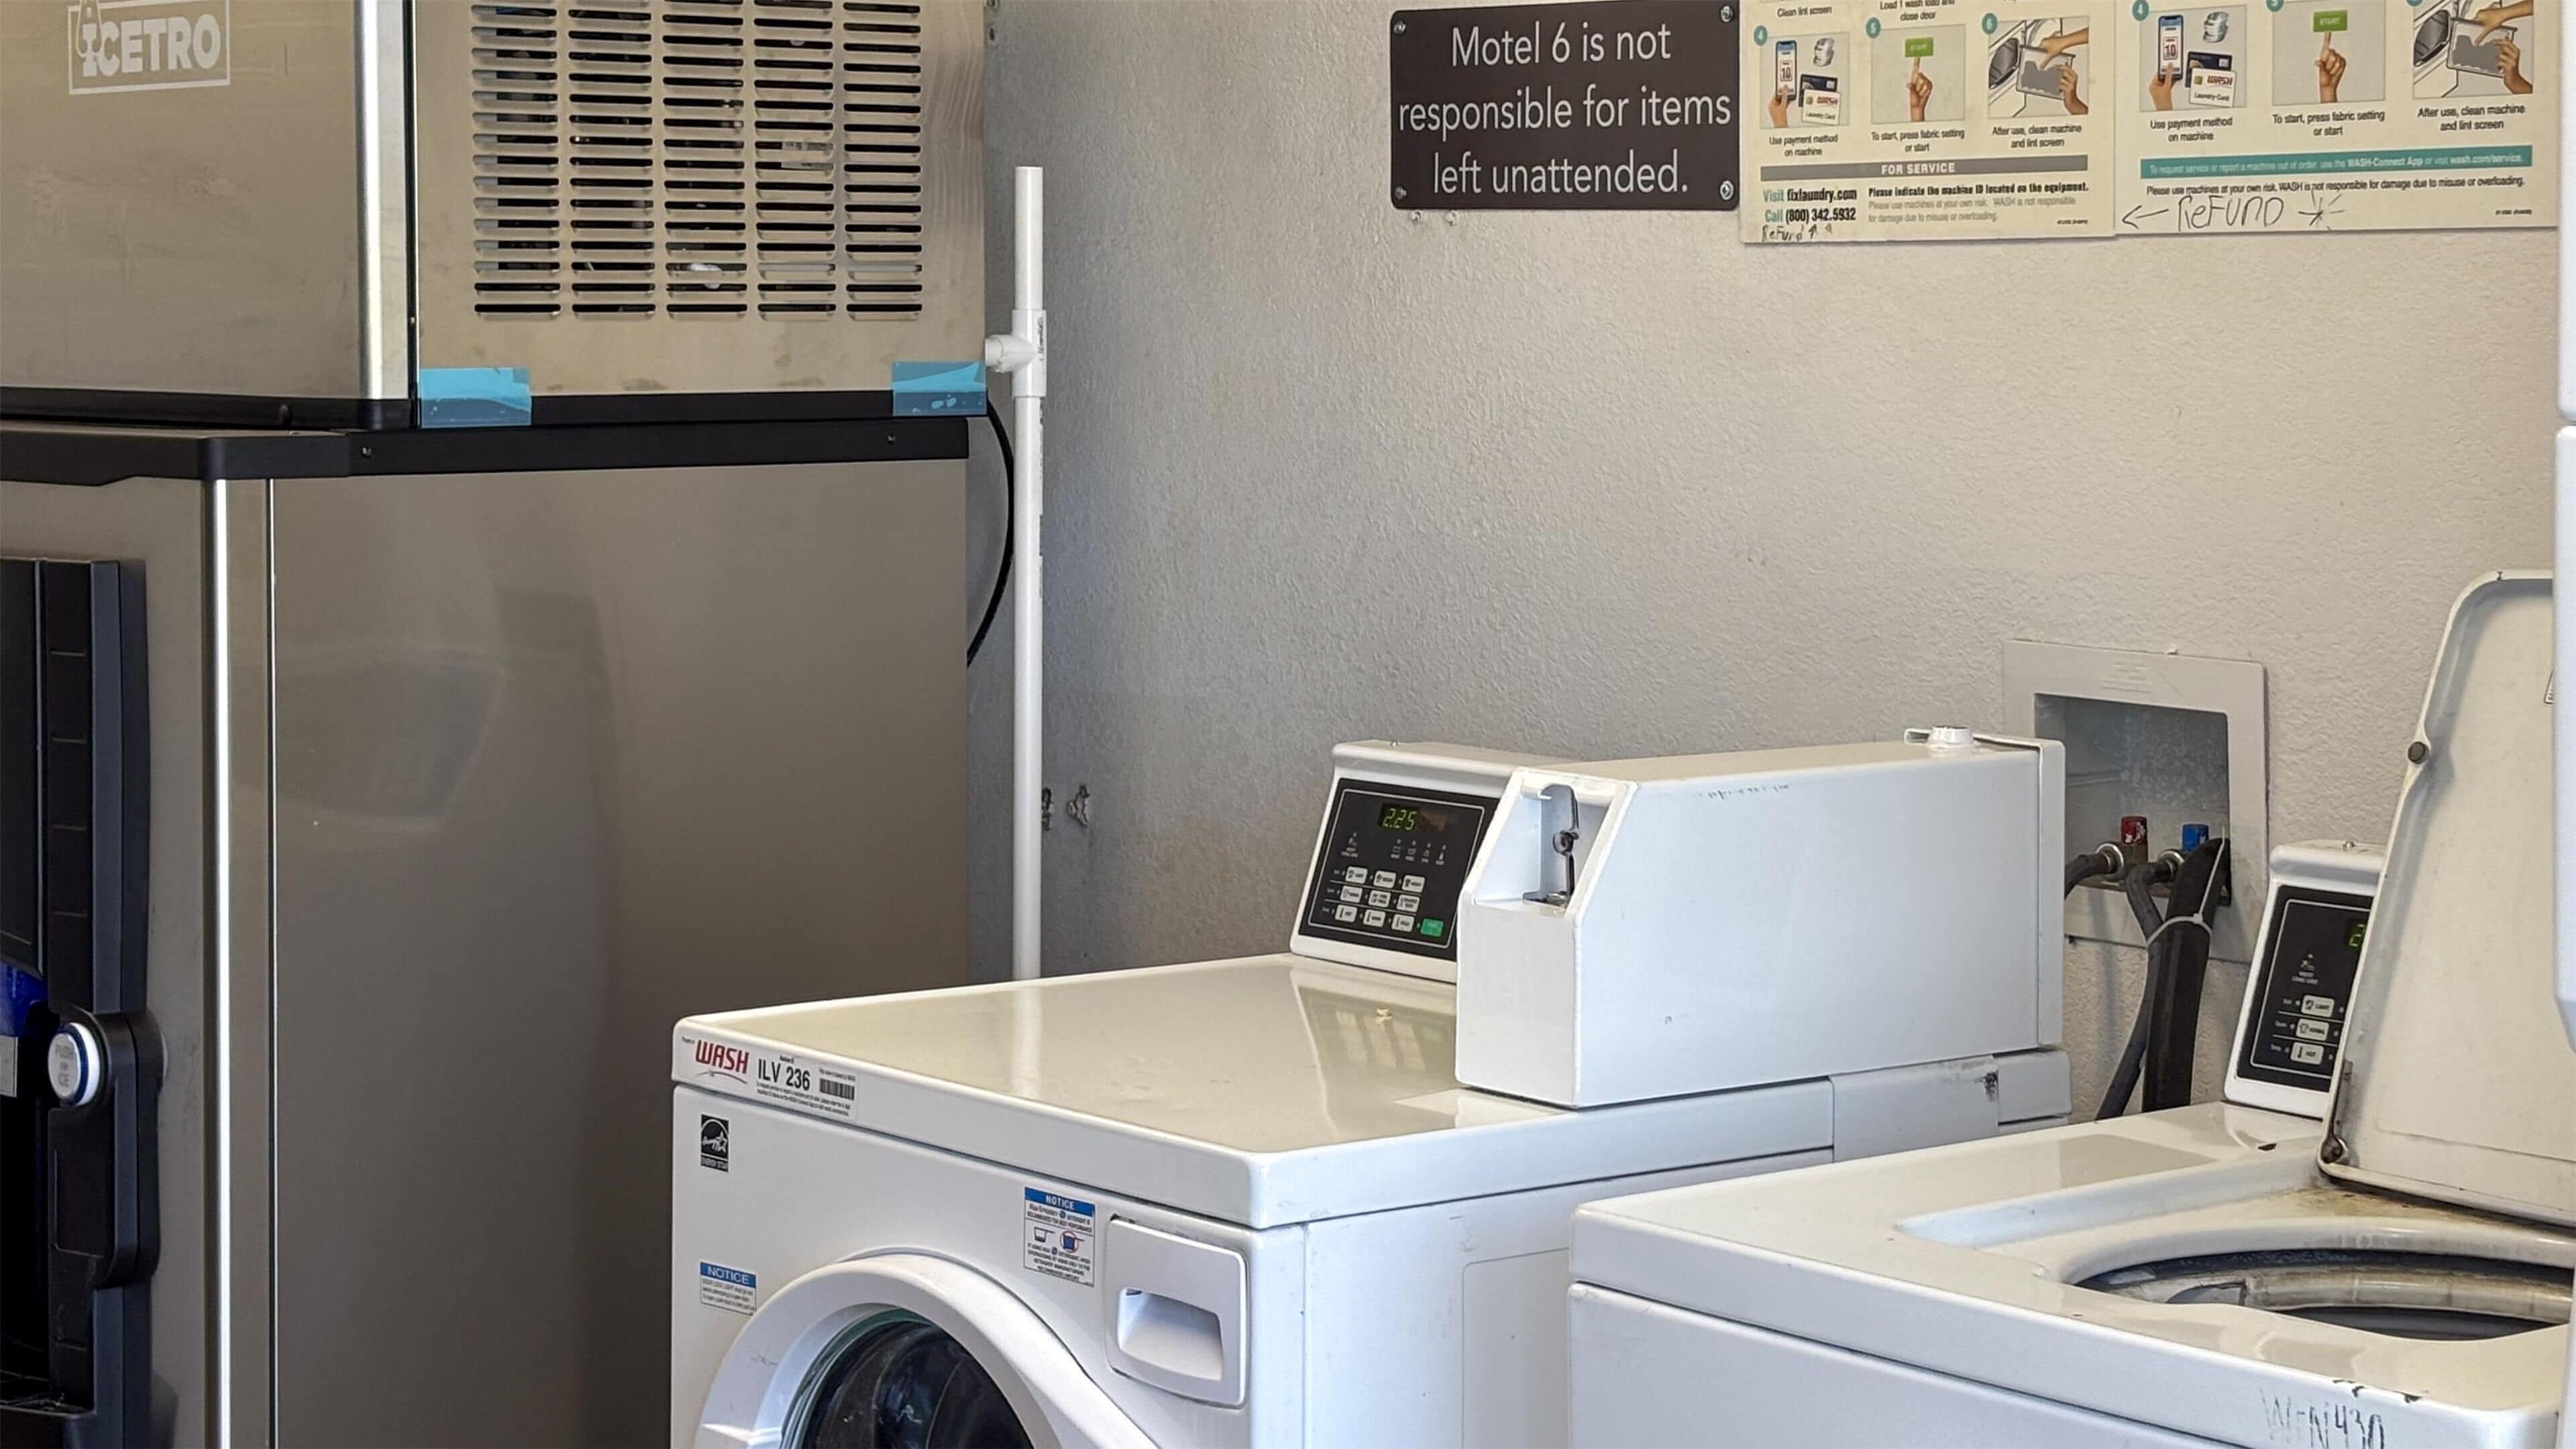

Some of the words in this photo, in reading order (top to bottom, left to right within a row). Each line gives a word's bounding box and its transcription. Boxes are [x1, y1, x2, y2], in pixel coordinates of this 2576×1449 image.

[1778, 8, 1796, 17] Clean
[1798, 7, 1808, 15] lint
[1810, 6, 1832, 15] screen
[1880, 1, 1897, 10] Load
[2137, 4, 2143, 15] 4
[1900, 11, 1919, 21] close
[1920, 10, 1936, 19] door
[1870, 21, 1876, 33] 5
[1986, 19, 1992, 30] 6
[1757, 29, 1764, 40] 4
[83, 14, 221, 78] ICETRO
[1452, 20, 1540, 66] Motel
[1552, 22, 1570, 63] 6
[1582, 21, 1604, 62] is
[1616, 23, 1671, 60] not
[1780, 67, 1790, 78] 10
[1399, 85, 1572, 142] responsible
[1582, 83, 1629, 127] for
[1641, 85, 1731, 125] items
[2418, 107, 2438, 117] After
[2440, 107, 2459, 117] use,
[2461, 105, 2485, 115] clean
[2487, 104, 2526, 115] machine
[2150, 120, 2165, 129] Use
[2167, 119, 2200, 131] payment
[2202, 116, 2233, 126] method
[2273, 114, 2283, 124] To
[2284, 114, 2305, 124] start,
[2307, 114, 2330, 125] press
[2332, 111, 2355, 121] fabric
[2357, 110, 2385, 122] setting
[1992, 125, 2010, 136] After
[2011, 127, 2026, 136] use,
[2028, 125, 2048, 134] clean
[2050, 124, 2082, 133] machine
[2324, 126, 2343, 136] start
[2440, 121, 2457, 131] and
[2459, 120, 2472, 129] lint
[2474, 119, 2504, 129] screen
[1769, 136, 1782, 145] Use
[1784, 135, 1811, 146] payment
[1813, 134, 1838, 143] method
[1871, 131, 1880, 141] To
[1881, 131, 1898, 141] start,
[1900, 131, 1919, 142] press
[1920, 129, 1940, 139] fabric
[1941, 129, 1965, 140] setting
[2168, 134, 2178, 142] on
[2180, 132, 2214, 142] machine
[1904, 144, 1913, 152] or
[1914, 143, 1930, 152] start
[2011, 139, 2025, 148] and
[2027, 138, 2037, 148] lint
[2039, 138, 2064, 147] screen
[1794, 147, 1822, 156] machine
[2407, 156, 2423, 167] App
[1434, 151, 1481, 193] left
[1493, 149, 1688, 193] unattended.
[1881, 164, 1903, 174] FOR
[1907, 162, 1955, 174] SERVICE
[1868, 187, 1892, 197] Please
[1894, 186, 1925, 197] indicate
[1927, 186, 1939, 196] the
[1941, 185, 1973, 195] machine
[1976, 184, 1983, 194] ID
[1986, 183, 2015, 194] located
[2017, 185, 2027, 193] on
[2029, 183, 2042, 193] the
[2044, 182, 2089, 193] equipment.
[2147, 186, 2170, 195] Please
[2171, 186, 2185, 195] use
[2186, 184, 2219, 195] machines
[2229, 184, 2245, 195] your
[2263, 183, 2277, 192] risk.
[2278, 182, 2302, 192] WASH
[2304, 183, 2310, 191] is
[2312, 182, 2324, 191] not
[2326, 179, 2367, 193] responsible
[2369, 179, 2379, 189] for
[2381, 178, 2411, 191] damage
[2412, 178, 2427, 188] due
[2428, 178, 2437, 186] to
[2438, 177, 2465, 186] misuse
[2467, 177, 2475, 186] or
[2477, 175, 2525, 188] overloading.
[1763, 190, 1784, 201] Visit
[1787, 187, 1857, 203] fixlaundry.com
[1868, 201, 1890, 210] Please
[1904, 201, 1934, 209] machines
[1943, 201, 1957, 210] your
[2025, 198, 2035, 206] not
[2037, 197, 2076, 208] responsible
[1765, 209, 1783, 222] Call
[1786, 209, 1809, 225] (800)
[1811, 207, 1856, 221] 342.5932
[1868, 214, 1876, 222] for
[1878, 213, 1903, 224] damage
[1904, 213, 1917, 221] due
[1918, 213, 1924, 221] to
[695, 1040, 750, 1074] WASH
[759, 1058, 781, 1083] ILV
[786, 1065, 810, 1091] 236
[1045, 1195, 1075, 1210] NOTICE
[708, 1266, 750, 1285] NOTICE
